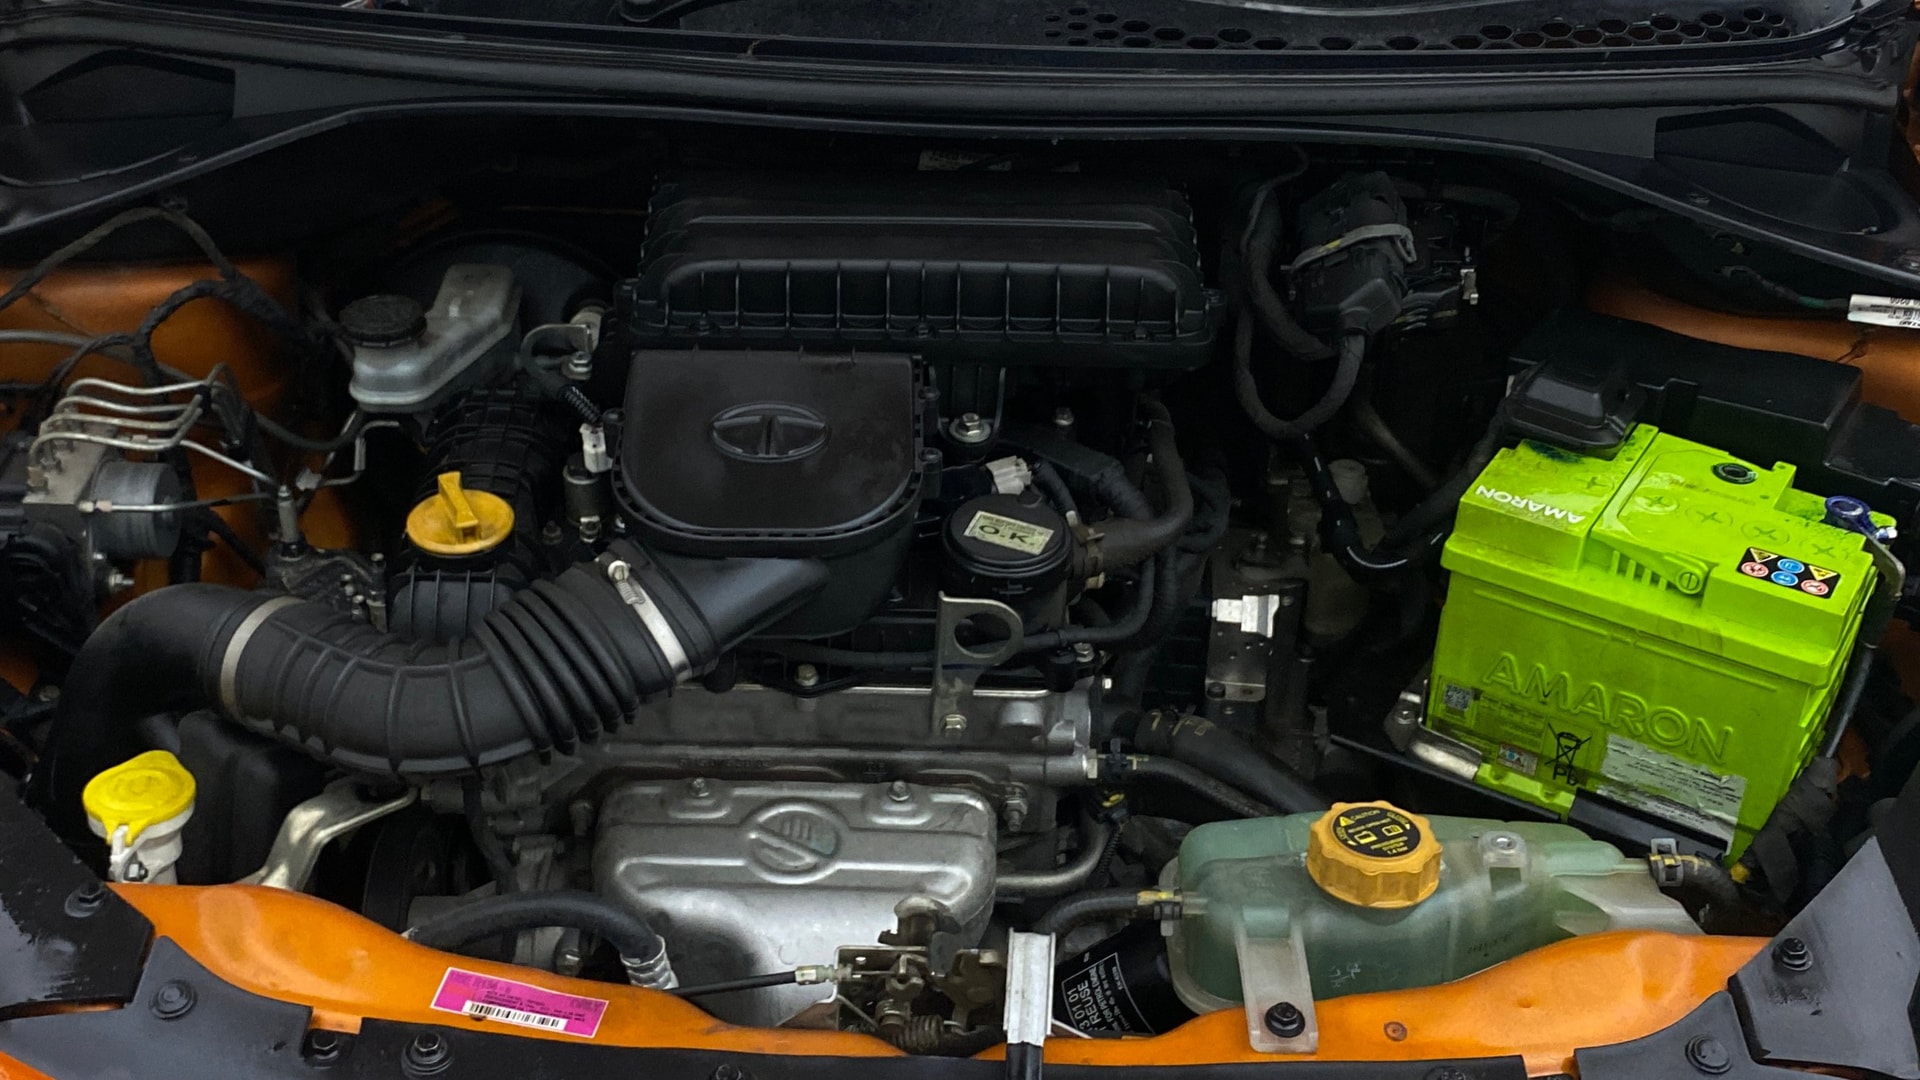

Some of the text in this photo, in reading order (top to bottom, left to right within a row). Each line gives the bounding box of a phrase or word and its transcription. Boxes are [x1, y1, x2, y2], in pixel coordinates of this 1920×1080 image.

[1475, 485, 1586, 524] AMARON
[1483, 652, 1734, 766] AMARON
[1066, 987, 1079, 1003] 01
[1073, 1004, 1085, 1020] 01
[1077, 979, 1102, 1025] REUSE
